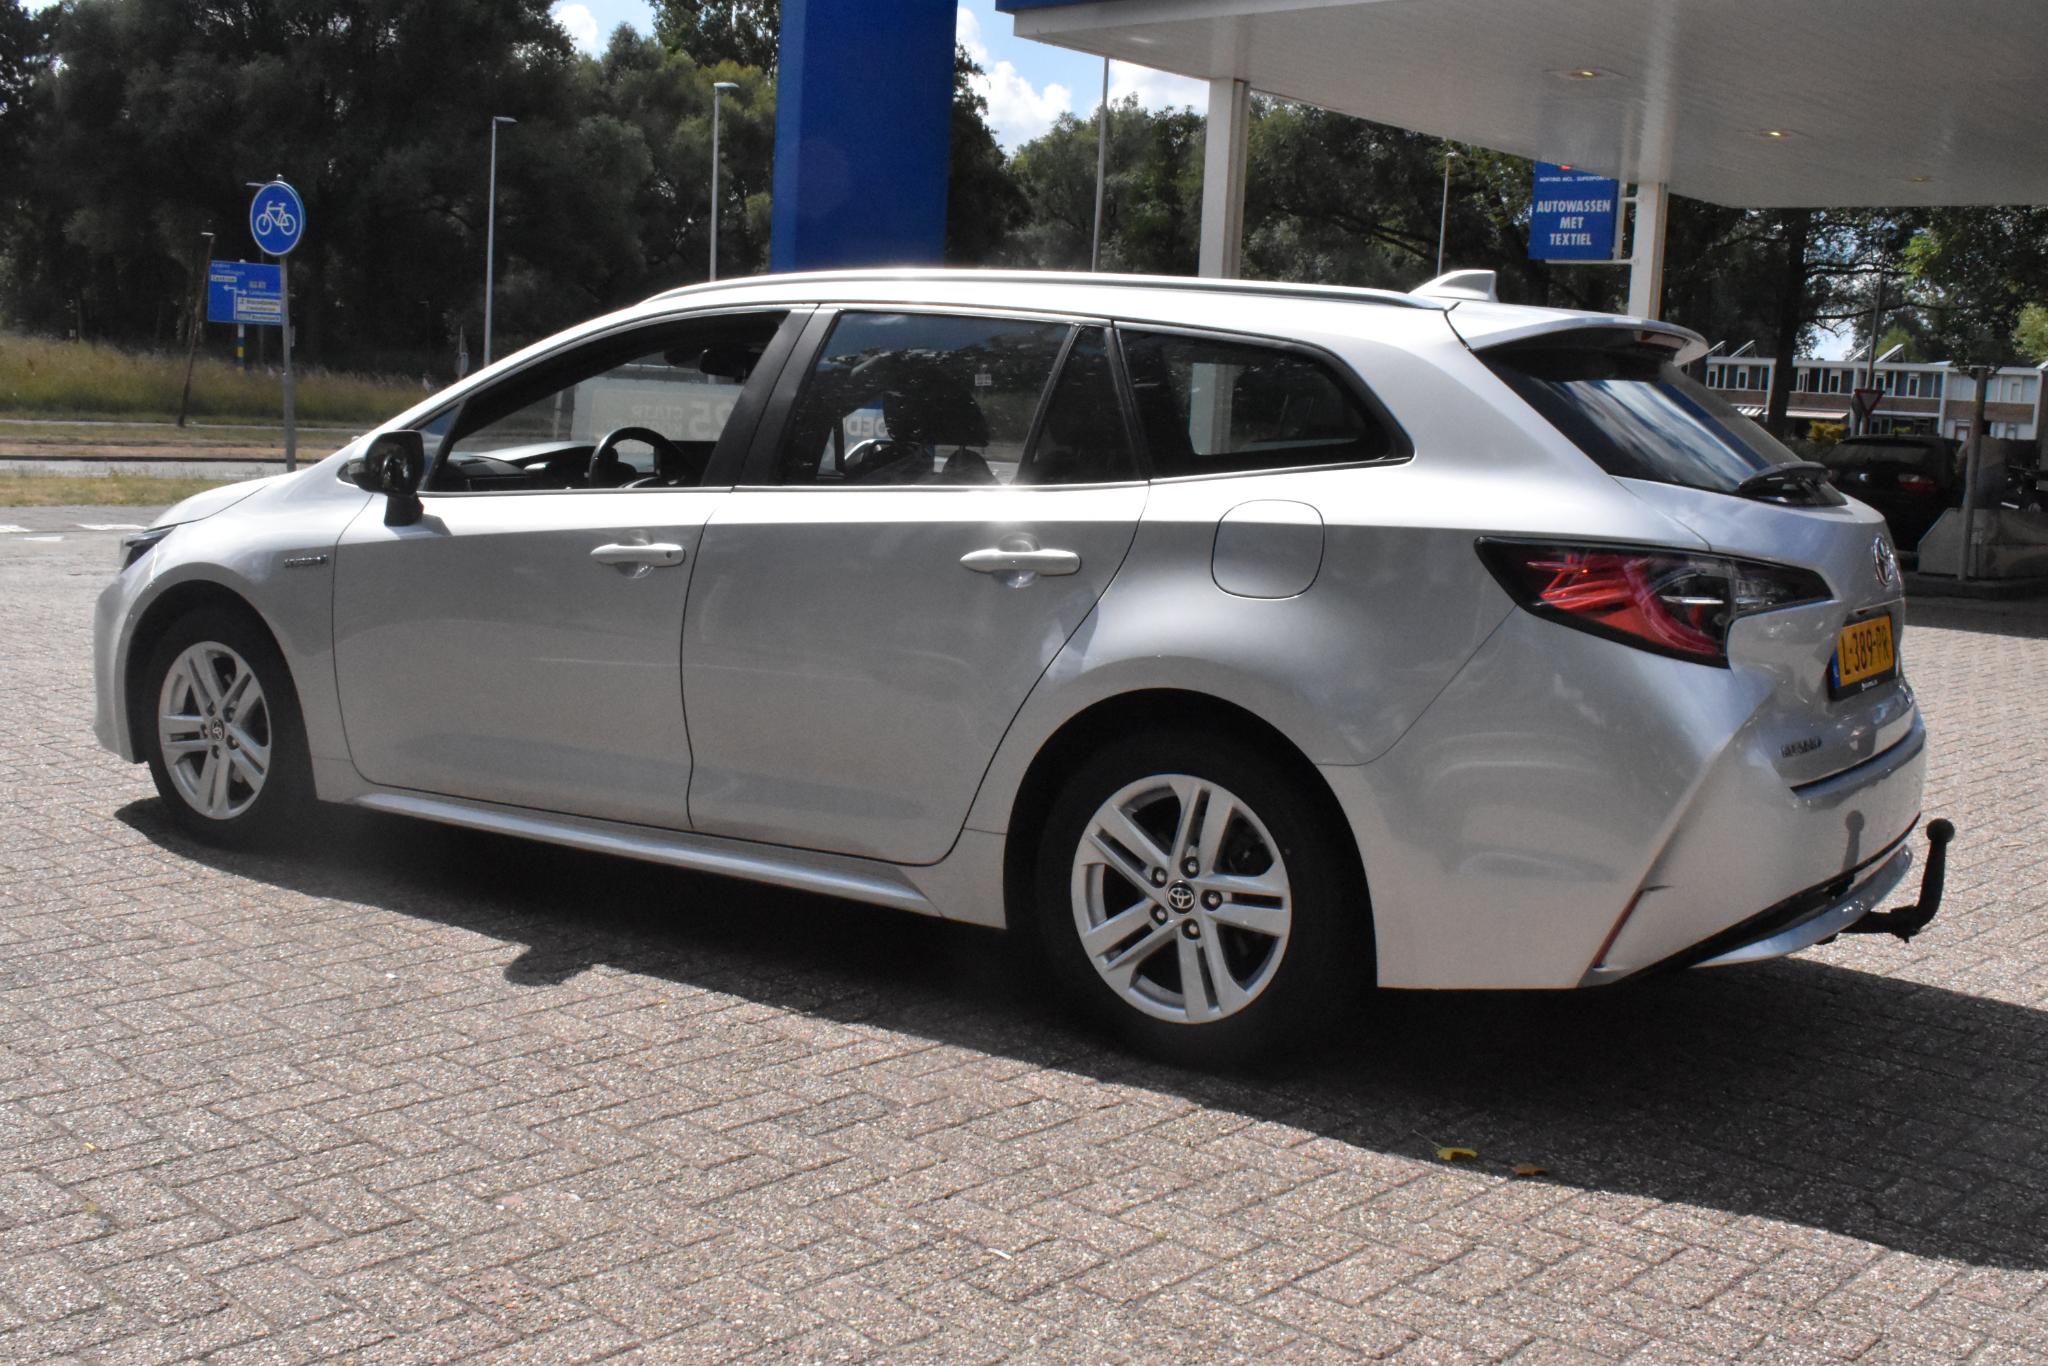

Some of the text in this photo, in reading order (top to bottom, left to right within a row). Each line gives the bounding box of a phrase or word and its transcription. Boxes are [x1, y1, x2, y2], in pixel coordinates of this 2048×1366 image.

[1536, 200, 1612, 213] AUTOWASSEN
[1559, 216, 1585, 229] MET
[1549, 233, 1592, 246] TEXTIEL
[1840, 624, 1889, 675] L-389-PR
